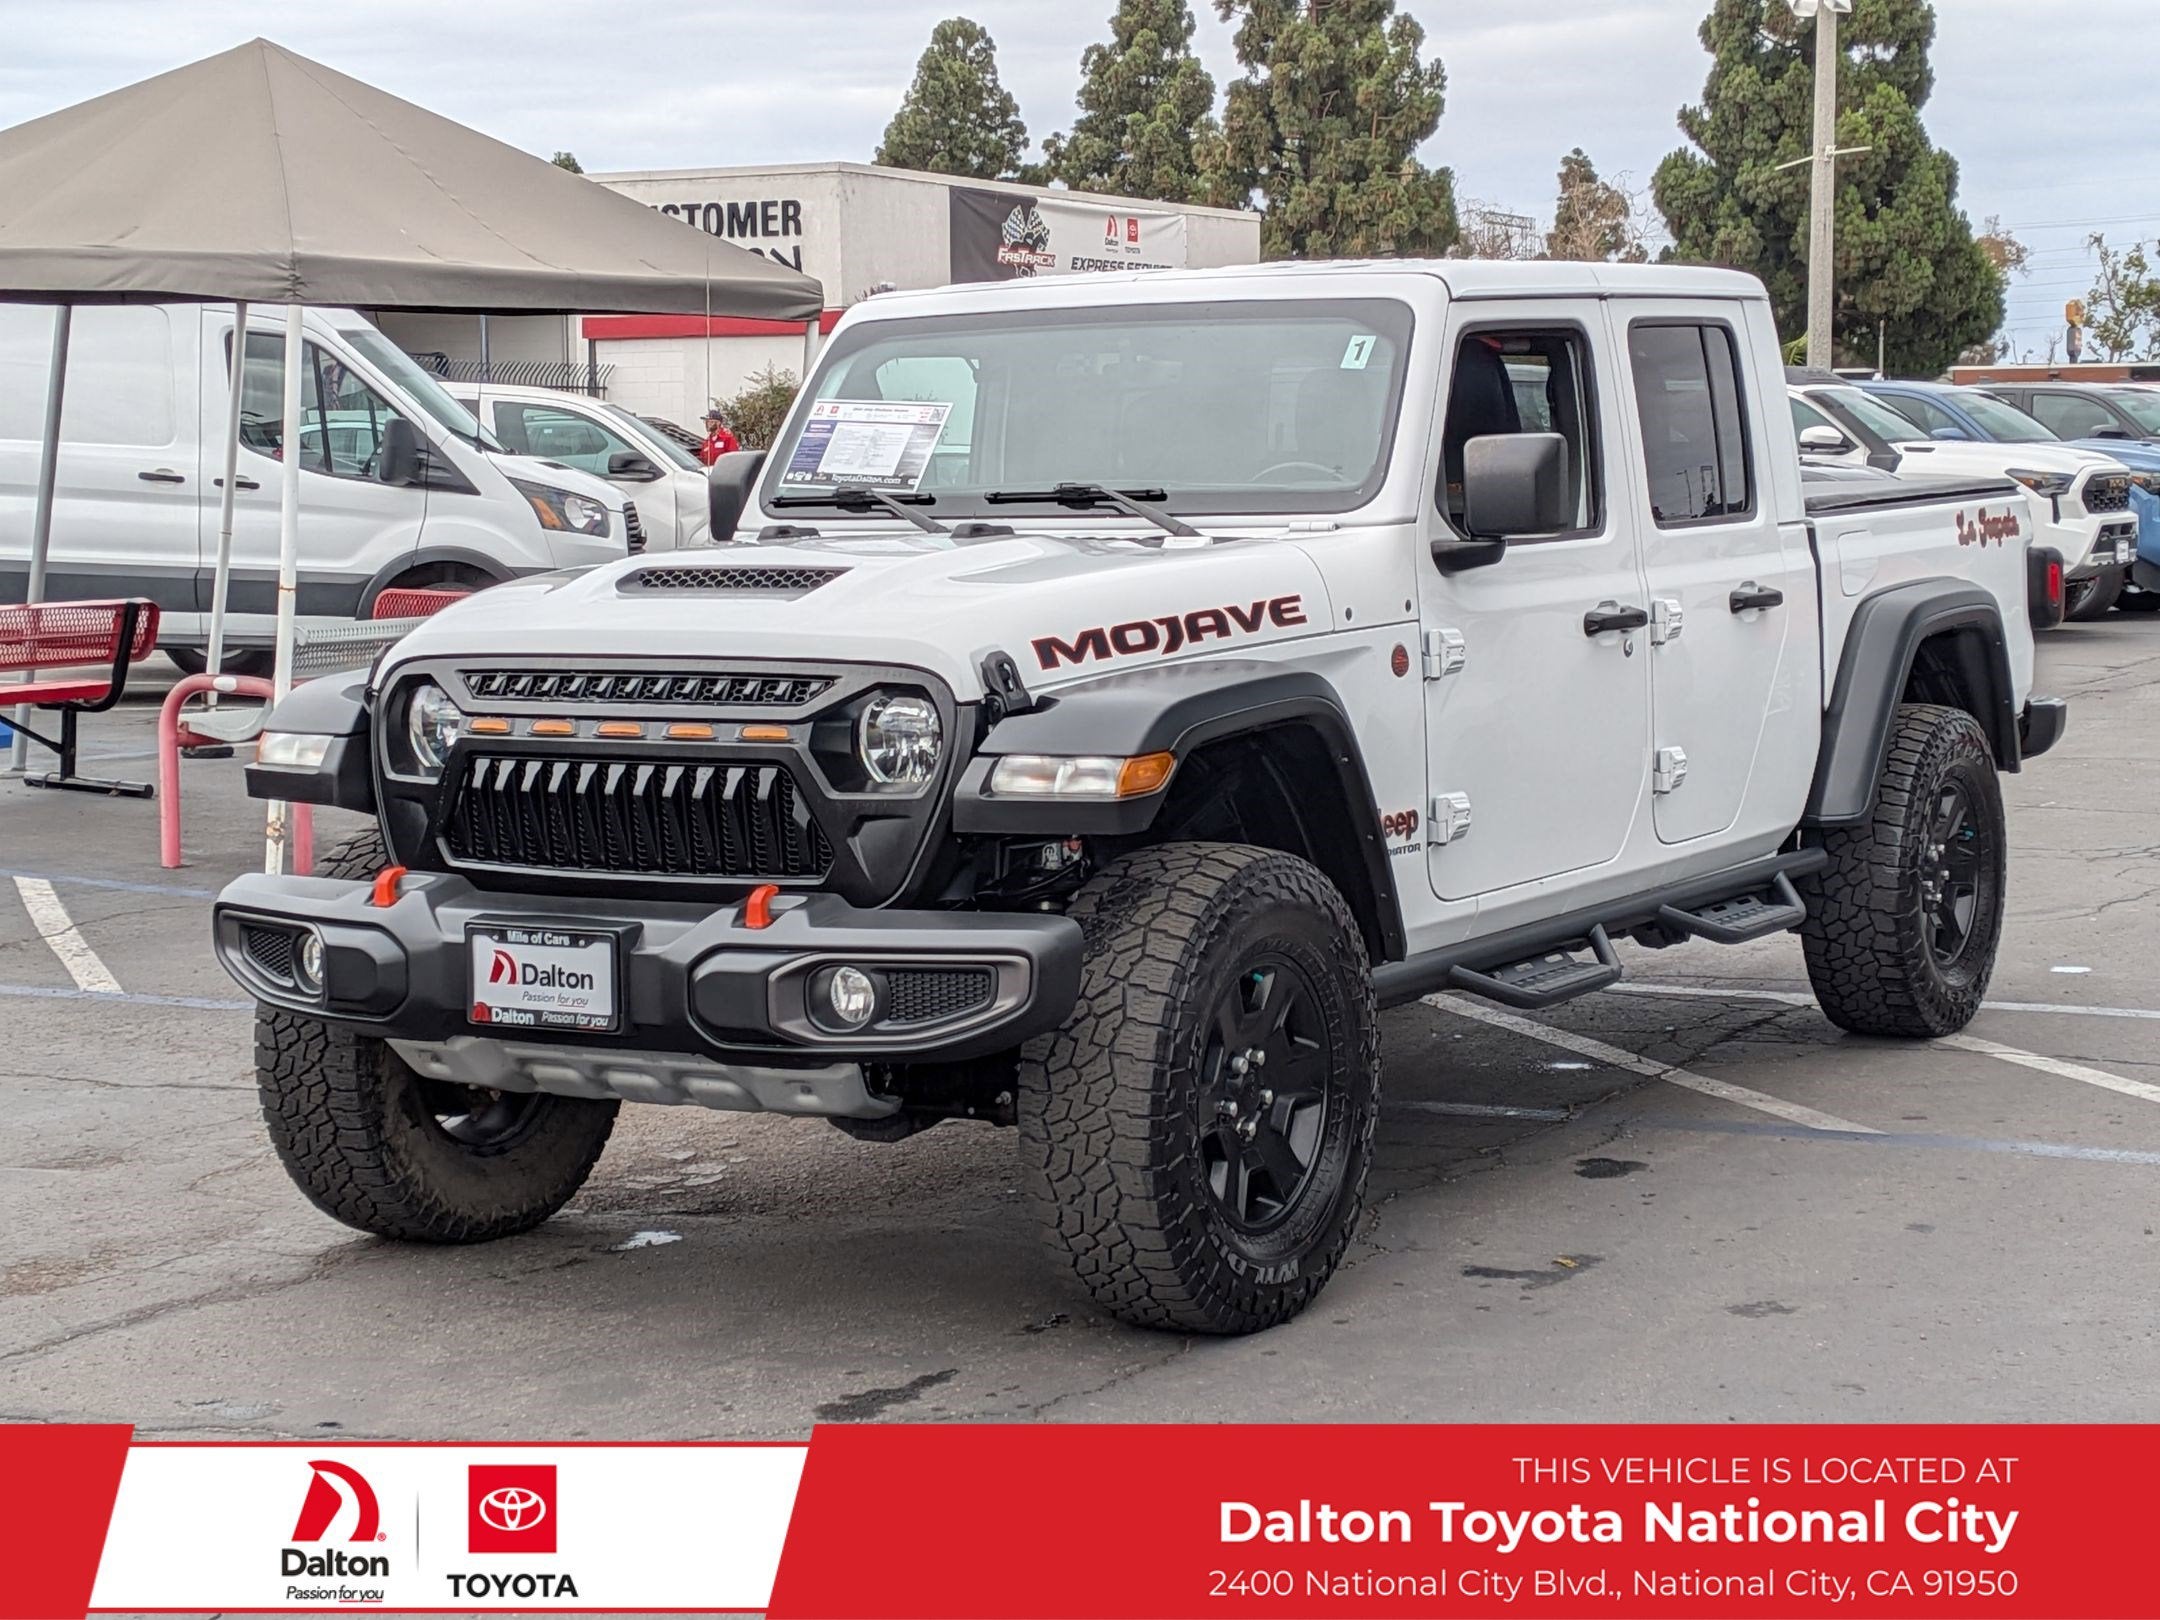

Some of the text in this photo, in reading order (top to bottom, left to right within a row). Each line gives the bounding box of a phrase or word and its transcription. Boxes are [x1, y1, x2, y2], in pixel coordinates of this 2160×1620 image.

[651, 200, 802, 238] TOMER
[1071, 257, 1125, 272] EXPRESS
[1354, 340, 1367, 361] 1
[1031, 594, 1308, 671] MOJAVE
[1378, 808, 1419, 841] eep
[506, 930, 570, 946] Mile of Cars
[521, 963, 594, 990] Dalton
[522, 991, 589, 1006] Passion for you
[491, 1007, 609, 1028] Dalton Passion for you
